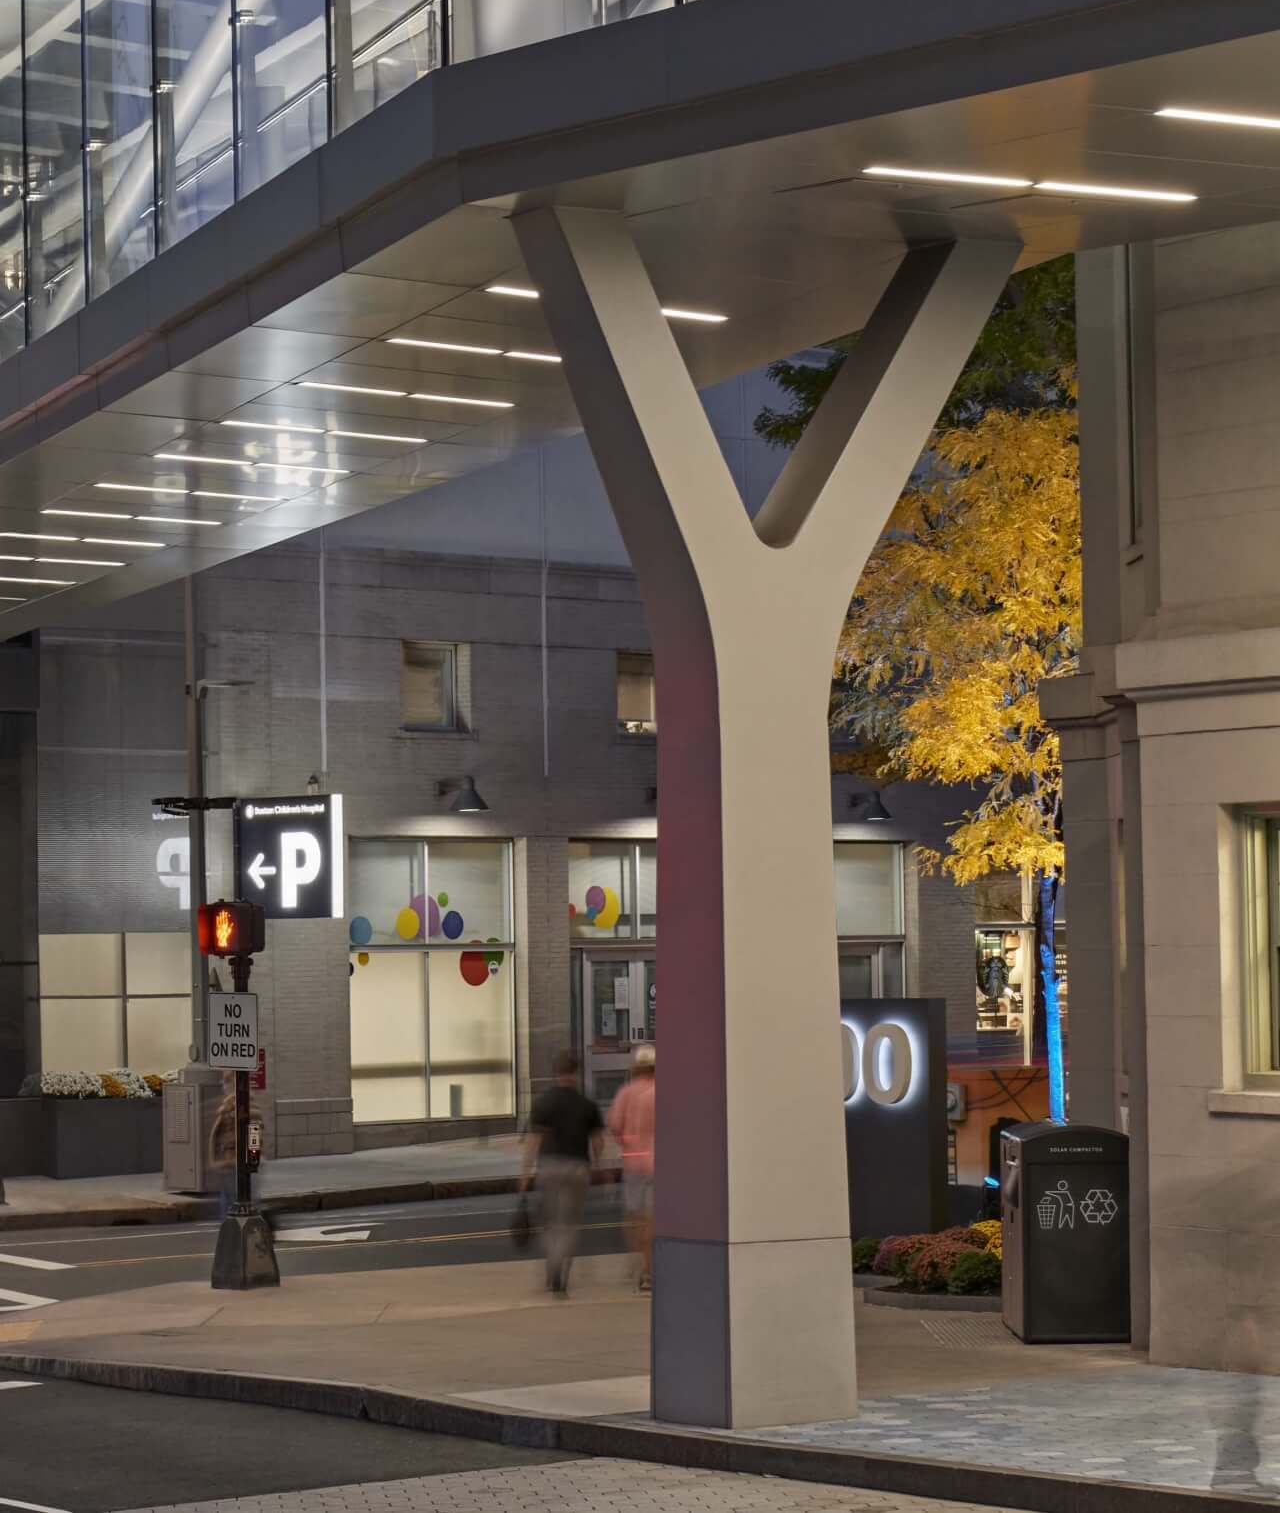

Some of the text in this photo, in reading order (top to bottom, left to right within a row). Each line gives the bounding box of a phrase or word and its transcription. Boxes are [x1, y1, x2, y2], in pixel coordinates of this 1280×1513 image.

[281, 832, 321, 908] P
[224, 1003, 242, 1018] NO
[217, 1023, 250, 1037] TURN
[211, 1042, 256, 1058] ON RED
